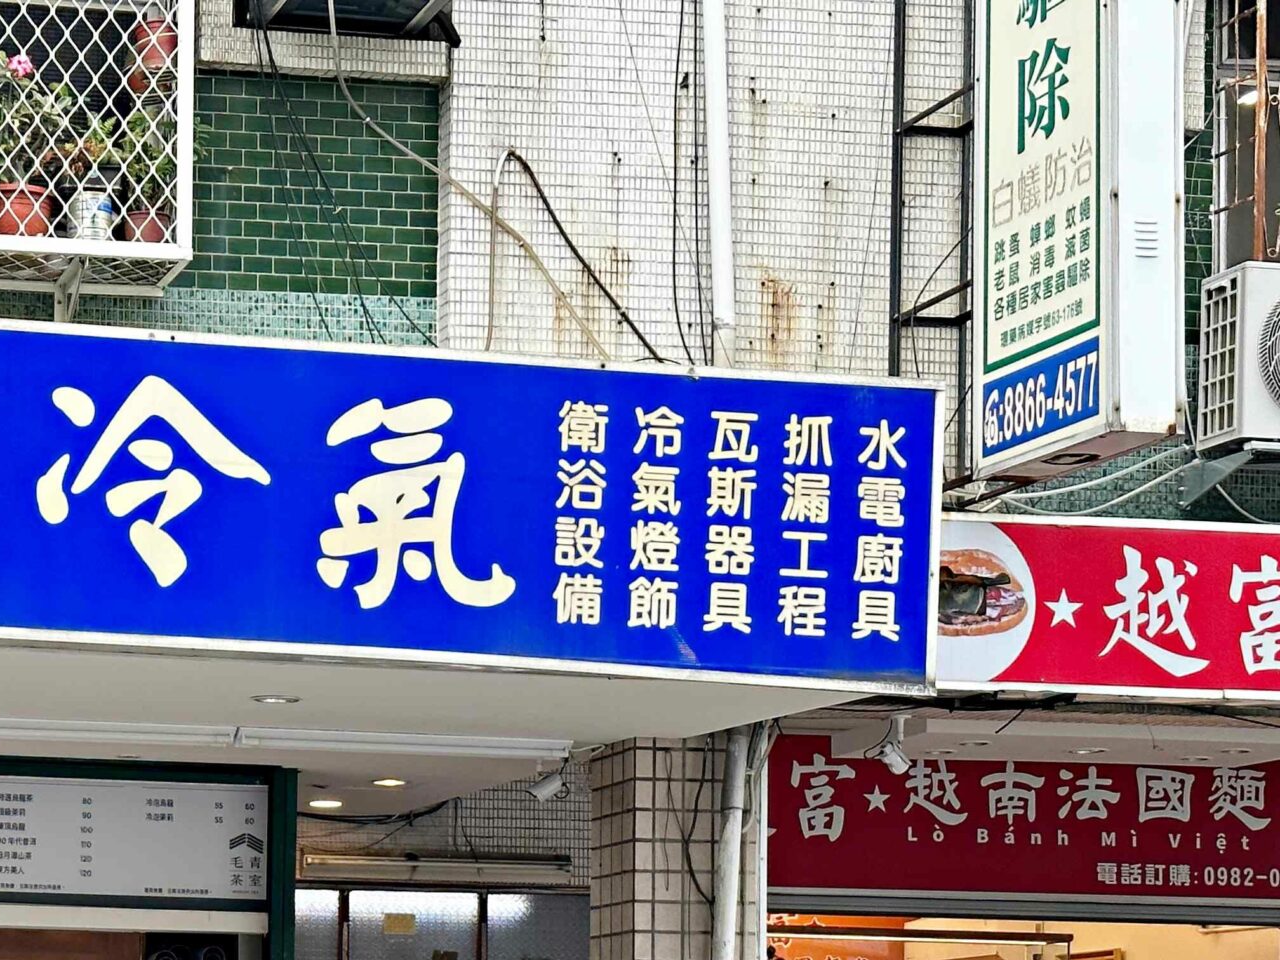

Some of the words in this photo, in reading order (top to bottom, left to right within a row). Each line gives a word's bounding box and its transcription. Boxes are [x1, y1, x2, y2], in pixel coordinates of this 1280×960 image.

[992, 136, 1093, 228] 白蟻防治
[994, 232, 1020, 265] 跳蚤
[994, 260, 1020, 291] 老鼠
[1029, 244, 1055, 277] 消毒
[1065, 226, 1091, 261] 滅菌
[551, 400, 609, 626] 衛浴設備
[627, 406, 685, 629] 冷氣燈飾
[702, 410, 760, 634] 瓦斯器具
[776, 414, 834, 638] 抓漏工程
[851, 418, 907, 642] 水電廚具
[790, 753, 856, 842] 富
[904, 760, 1271, 831] 越南法國麵
[907, 826, 945, 842] Lò
[978, 828, 1069, 846] Bánh
[1101, 830, 1138, 847] Mì
[1168, 832, 1250, 854] Việt
[230, 855, 261, 869] 毛青
[230, 873, 262, 887] 茶室
